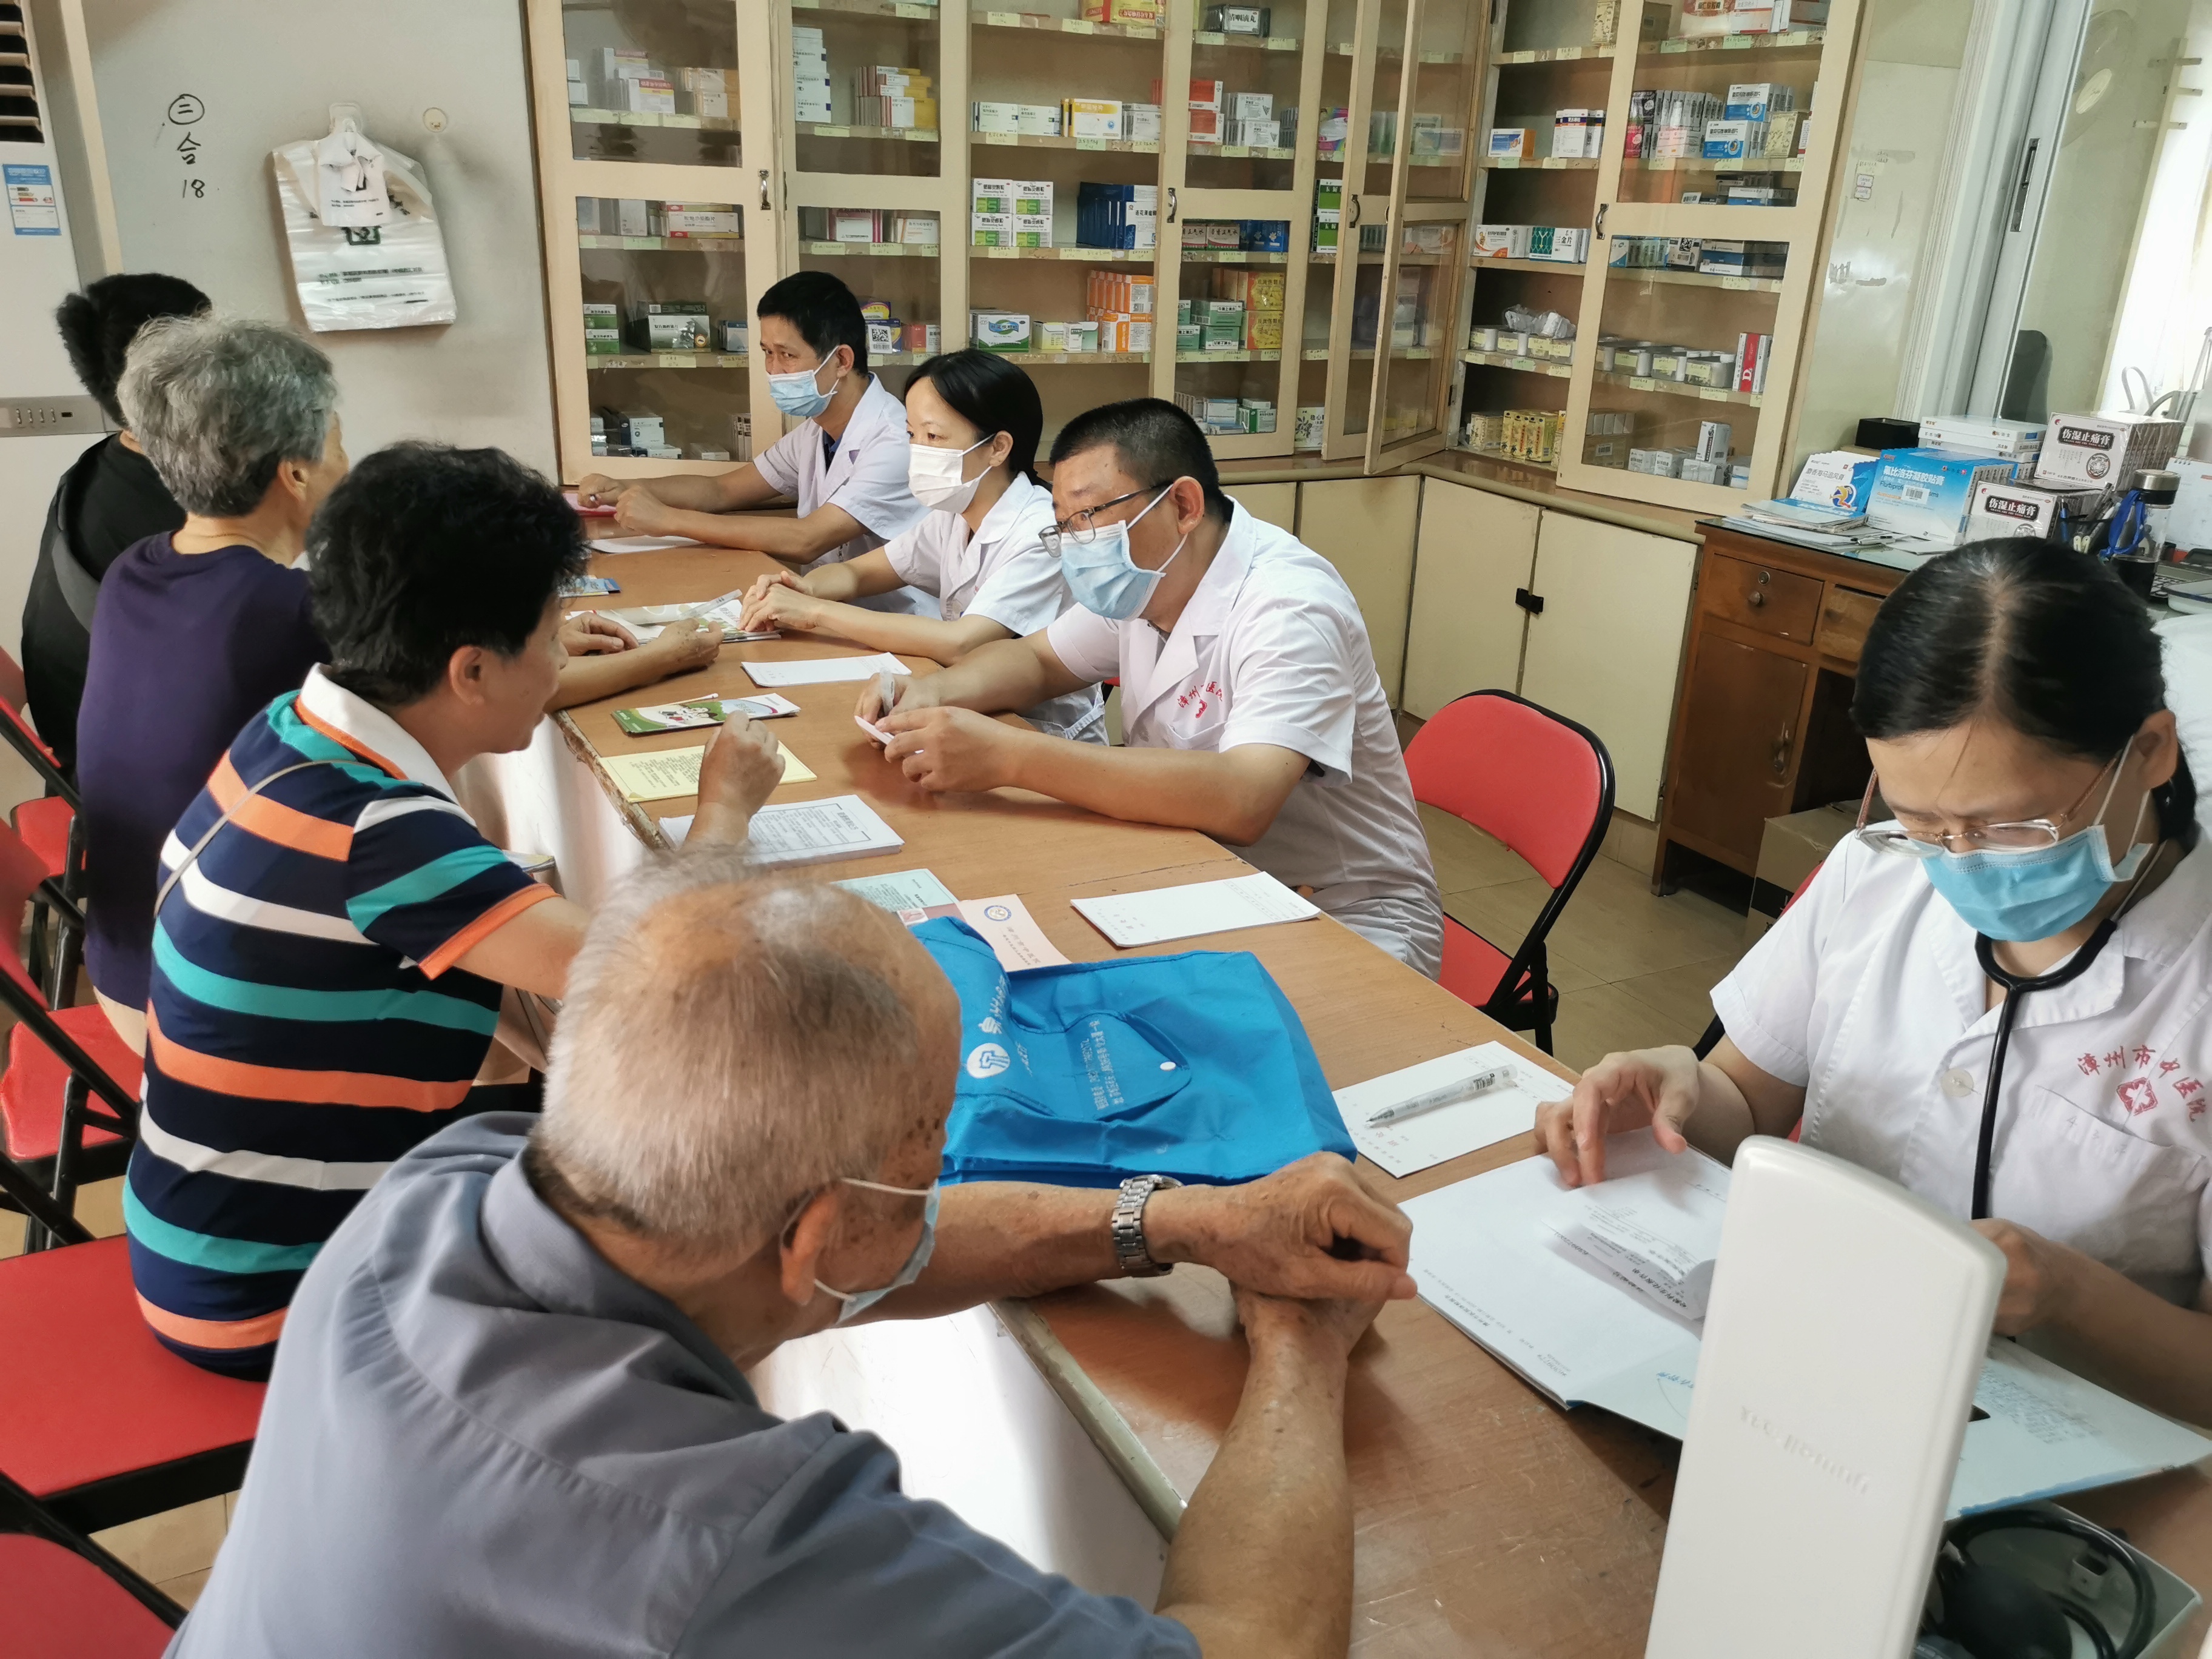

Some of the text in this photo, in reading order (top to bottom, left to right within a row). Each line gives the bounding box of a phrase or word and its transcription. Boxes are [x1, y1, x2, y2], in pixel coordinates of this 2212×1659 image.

[183, 179, 205, 198] 18
[1555, 236, 1573, 244] 三金片
[2062, 428, 2111, 446] 伤湿止痛膏
[1805, 468, 1846, 481] 麝香海马追风膏
[1883, 466, 1945, 486] 氟比洛芬凝胶贴膏
[1880, 481, 1904, 491] Flurbiprofe
[1988, 498, 2036, 515] 伤湿止痛膏
[1177, 681, 1223, 708] 漳州医院
[2077, 1044, 2207, 1122] 漳州市中医院
